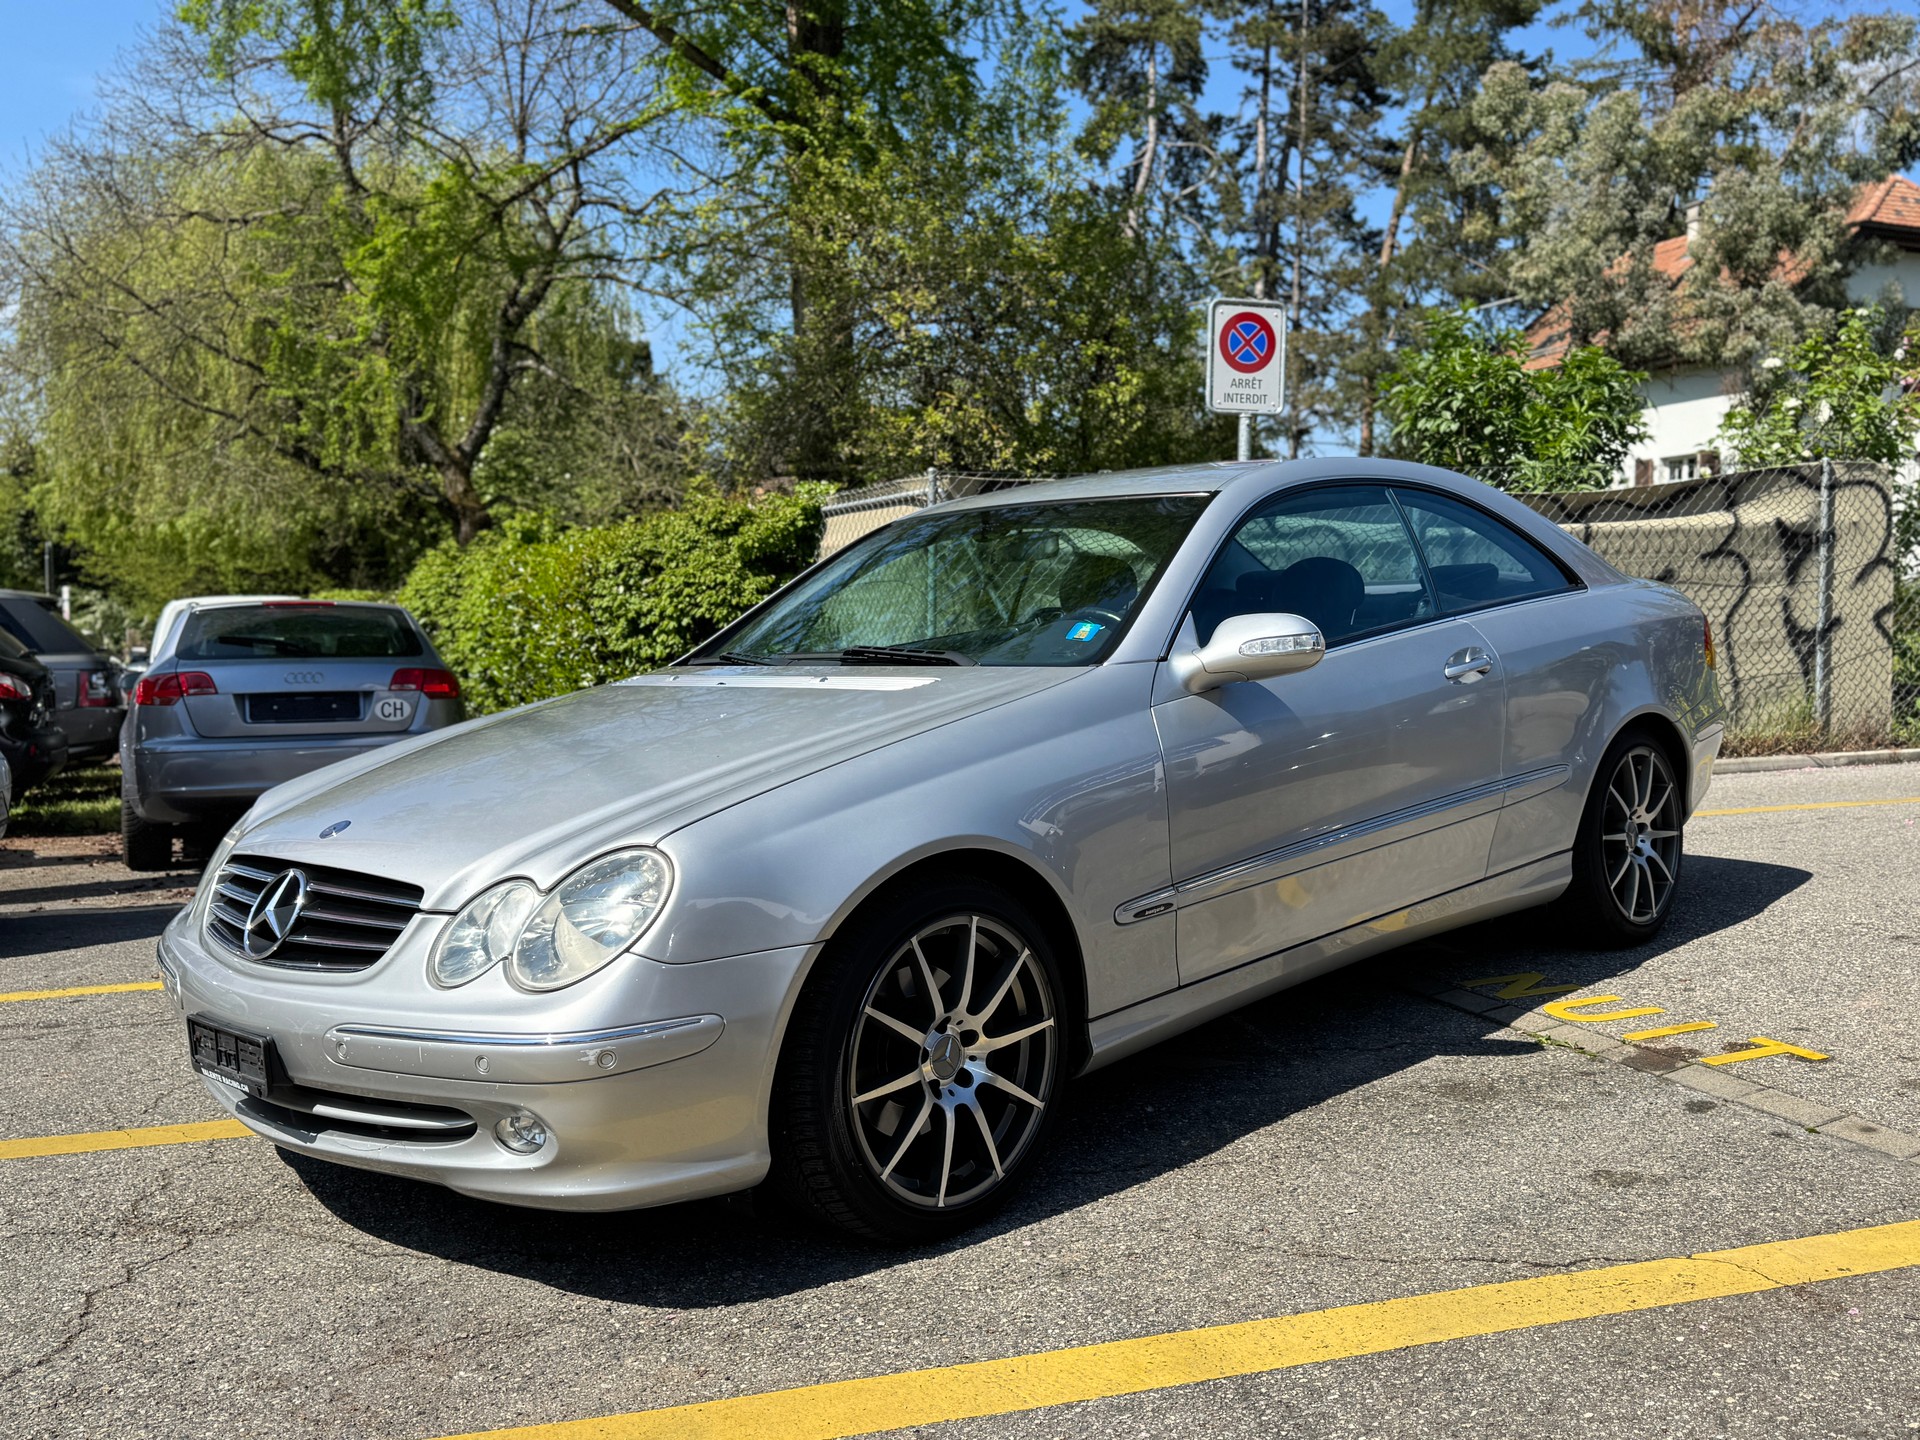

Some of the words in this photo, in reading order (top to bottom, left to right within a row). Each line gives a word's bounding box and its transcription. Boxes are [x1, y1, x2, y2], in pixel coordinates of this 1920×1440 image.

[1230, 377, 1263, 389] ARRÊT
[1223, 392, 1268, 404] INTERDIT
[381, 701, 404, 718] CH
[1461, 971, 1830, 1066] NUIT
